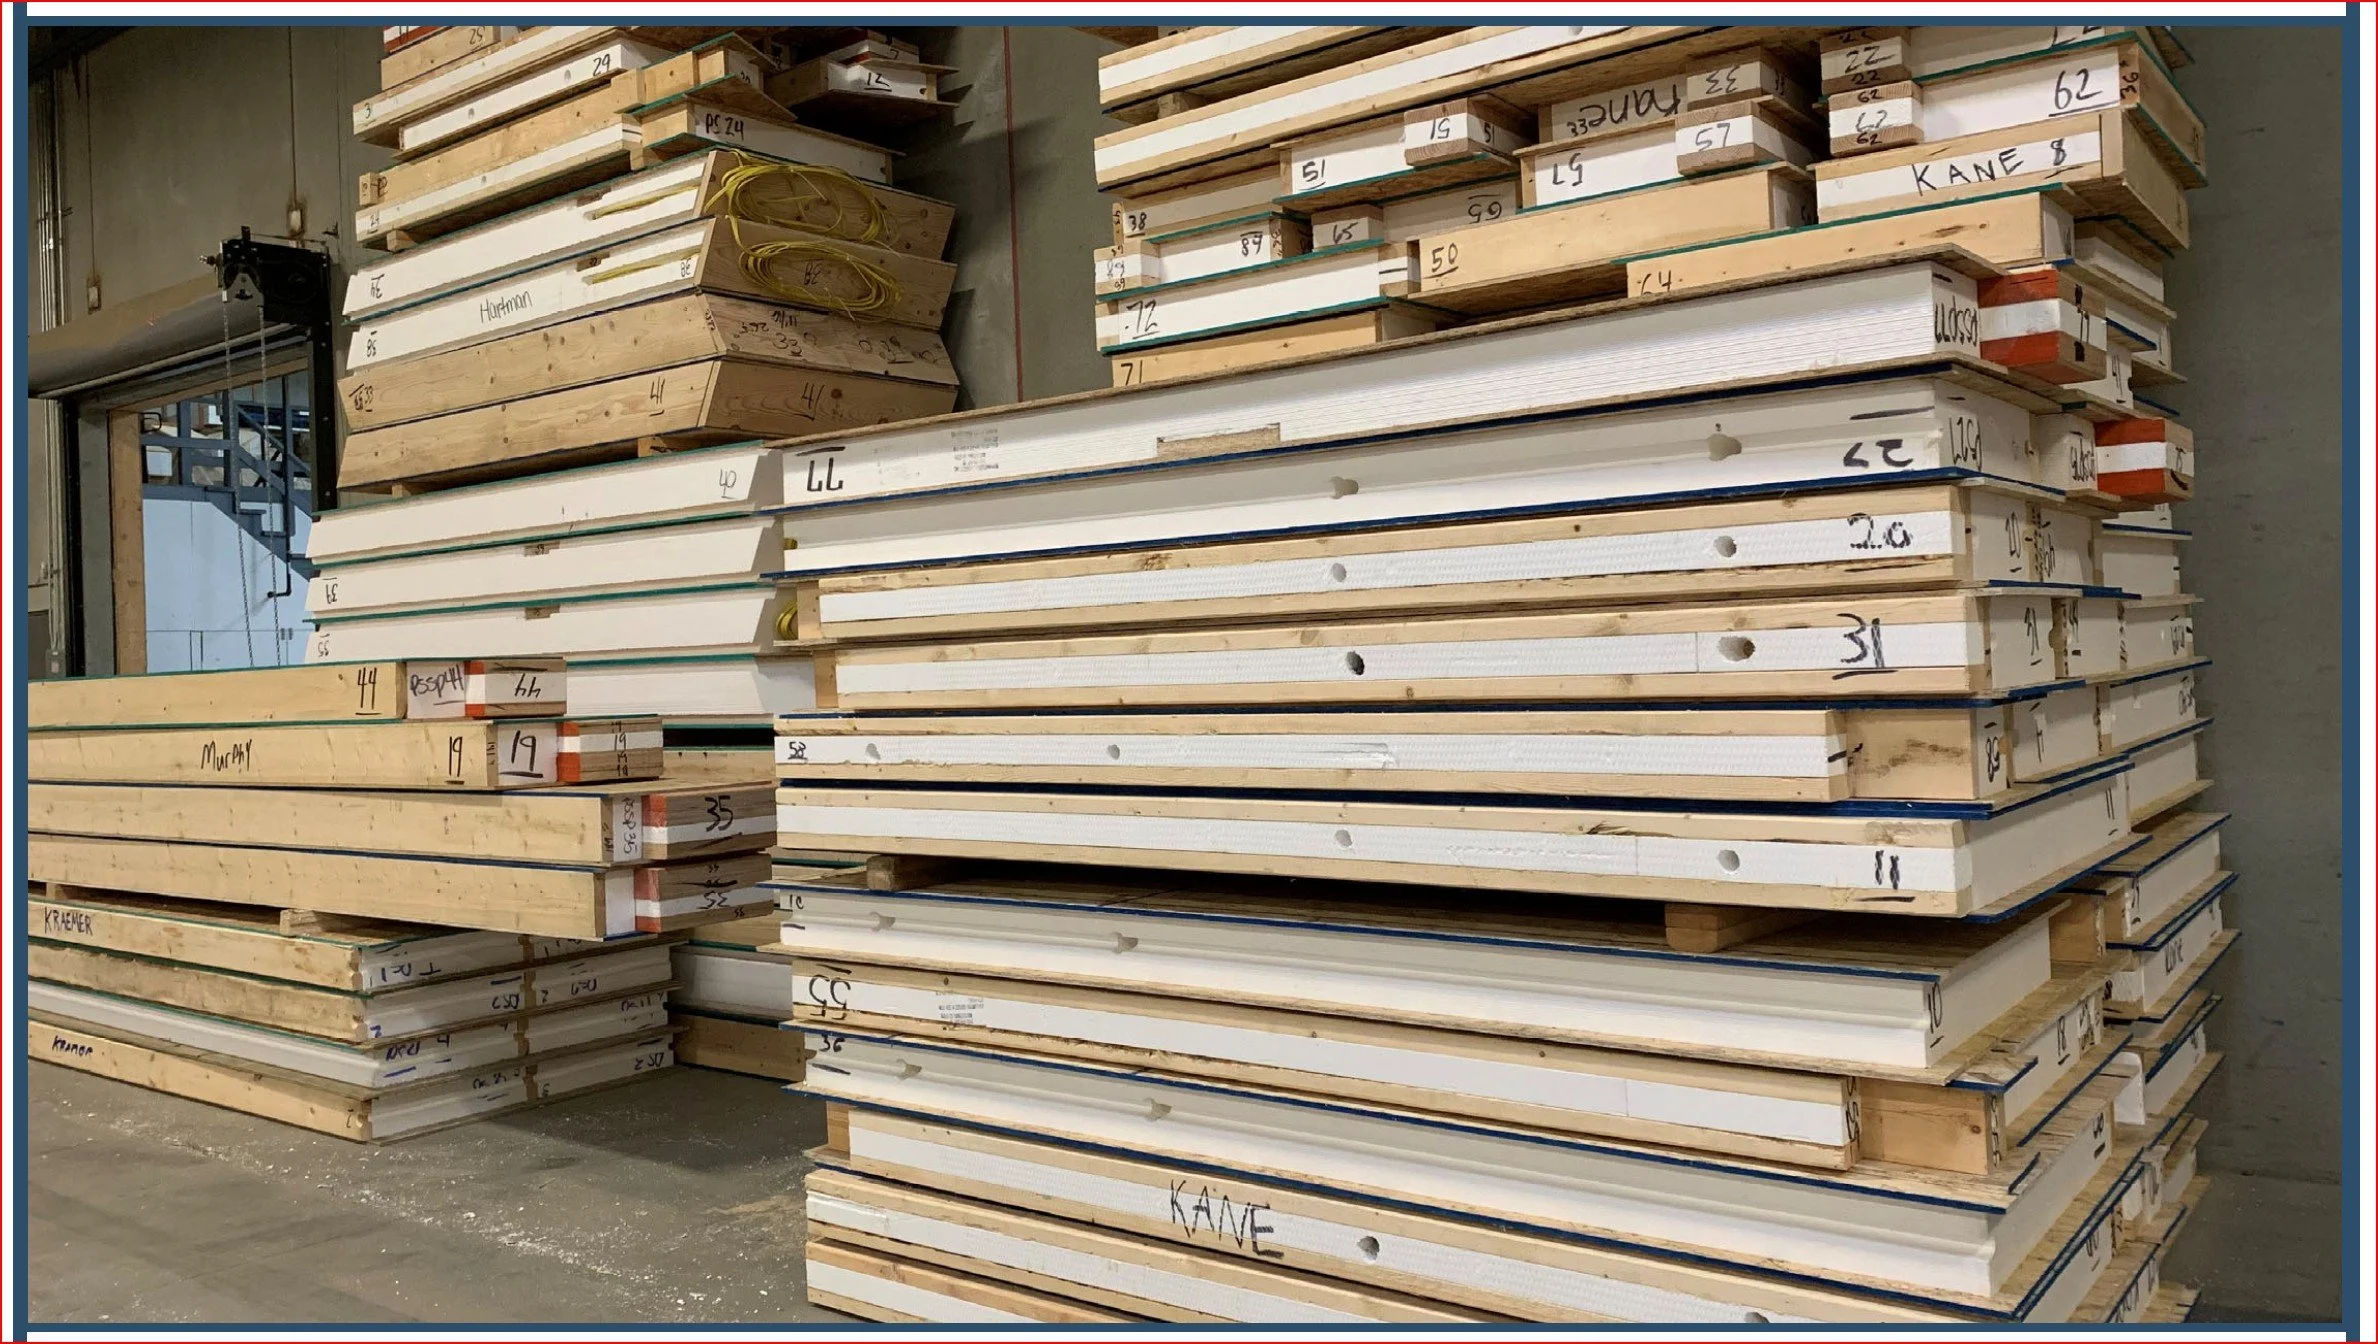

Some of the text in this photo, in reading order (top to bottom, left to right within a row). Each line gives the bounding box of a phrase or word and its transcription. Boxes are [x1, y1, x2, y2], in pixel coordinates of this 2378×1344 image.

[593, 53, 611, 77] 29
[1857, 88, 1880, 103] 62
[2054, 68, 2102, 110] 62
[1695, 122, 1731, 151] 57
[1856, 132, 1883, 146] 62
[1302, 158, 1326, 183] 51
[1911, 138, 2068, 197] KANE 8
[1128, 212, 1148, 231] 38
[1332, 222, 1359, 241] 65
[1430, 242, 1458, 274] 50
[480, 291, 534, 324] Hartman
[1120, 360, 1144, 386] 71
[650, 376, 667, 405] 41
[801, 382, 825, 413] 41
[719, 467, 737, 492] 40
[1836, 612, 1886, 669] 31
[356, 666, 378, 711] 44
[449, 735, 463, 778] 19
[510, 729, 538, 773] 19
[613, 732, 627, 751] 19
[704, 795, 734, 832] 35
[1873, 850, 1901, 890] 11
[788, 894, 805, 911] 10
[43, 906, 94, 936] KRAEMER
[1928, 981, 1944, 1034] 10
[1169, 1177, 1284, 1260] KANE
